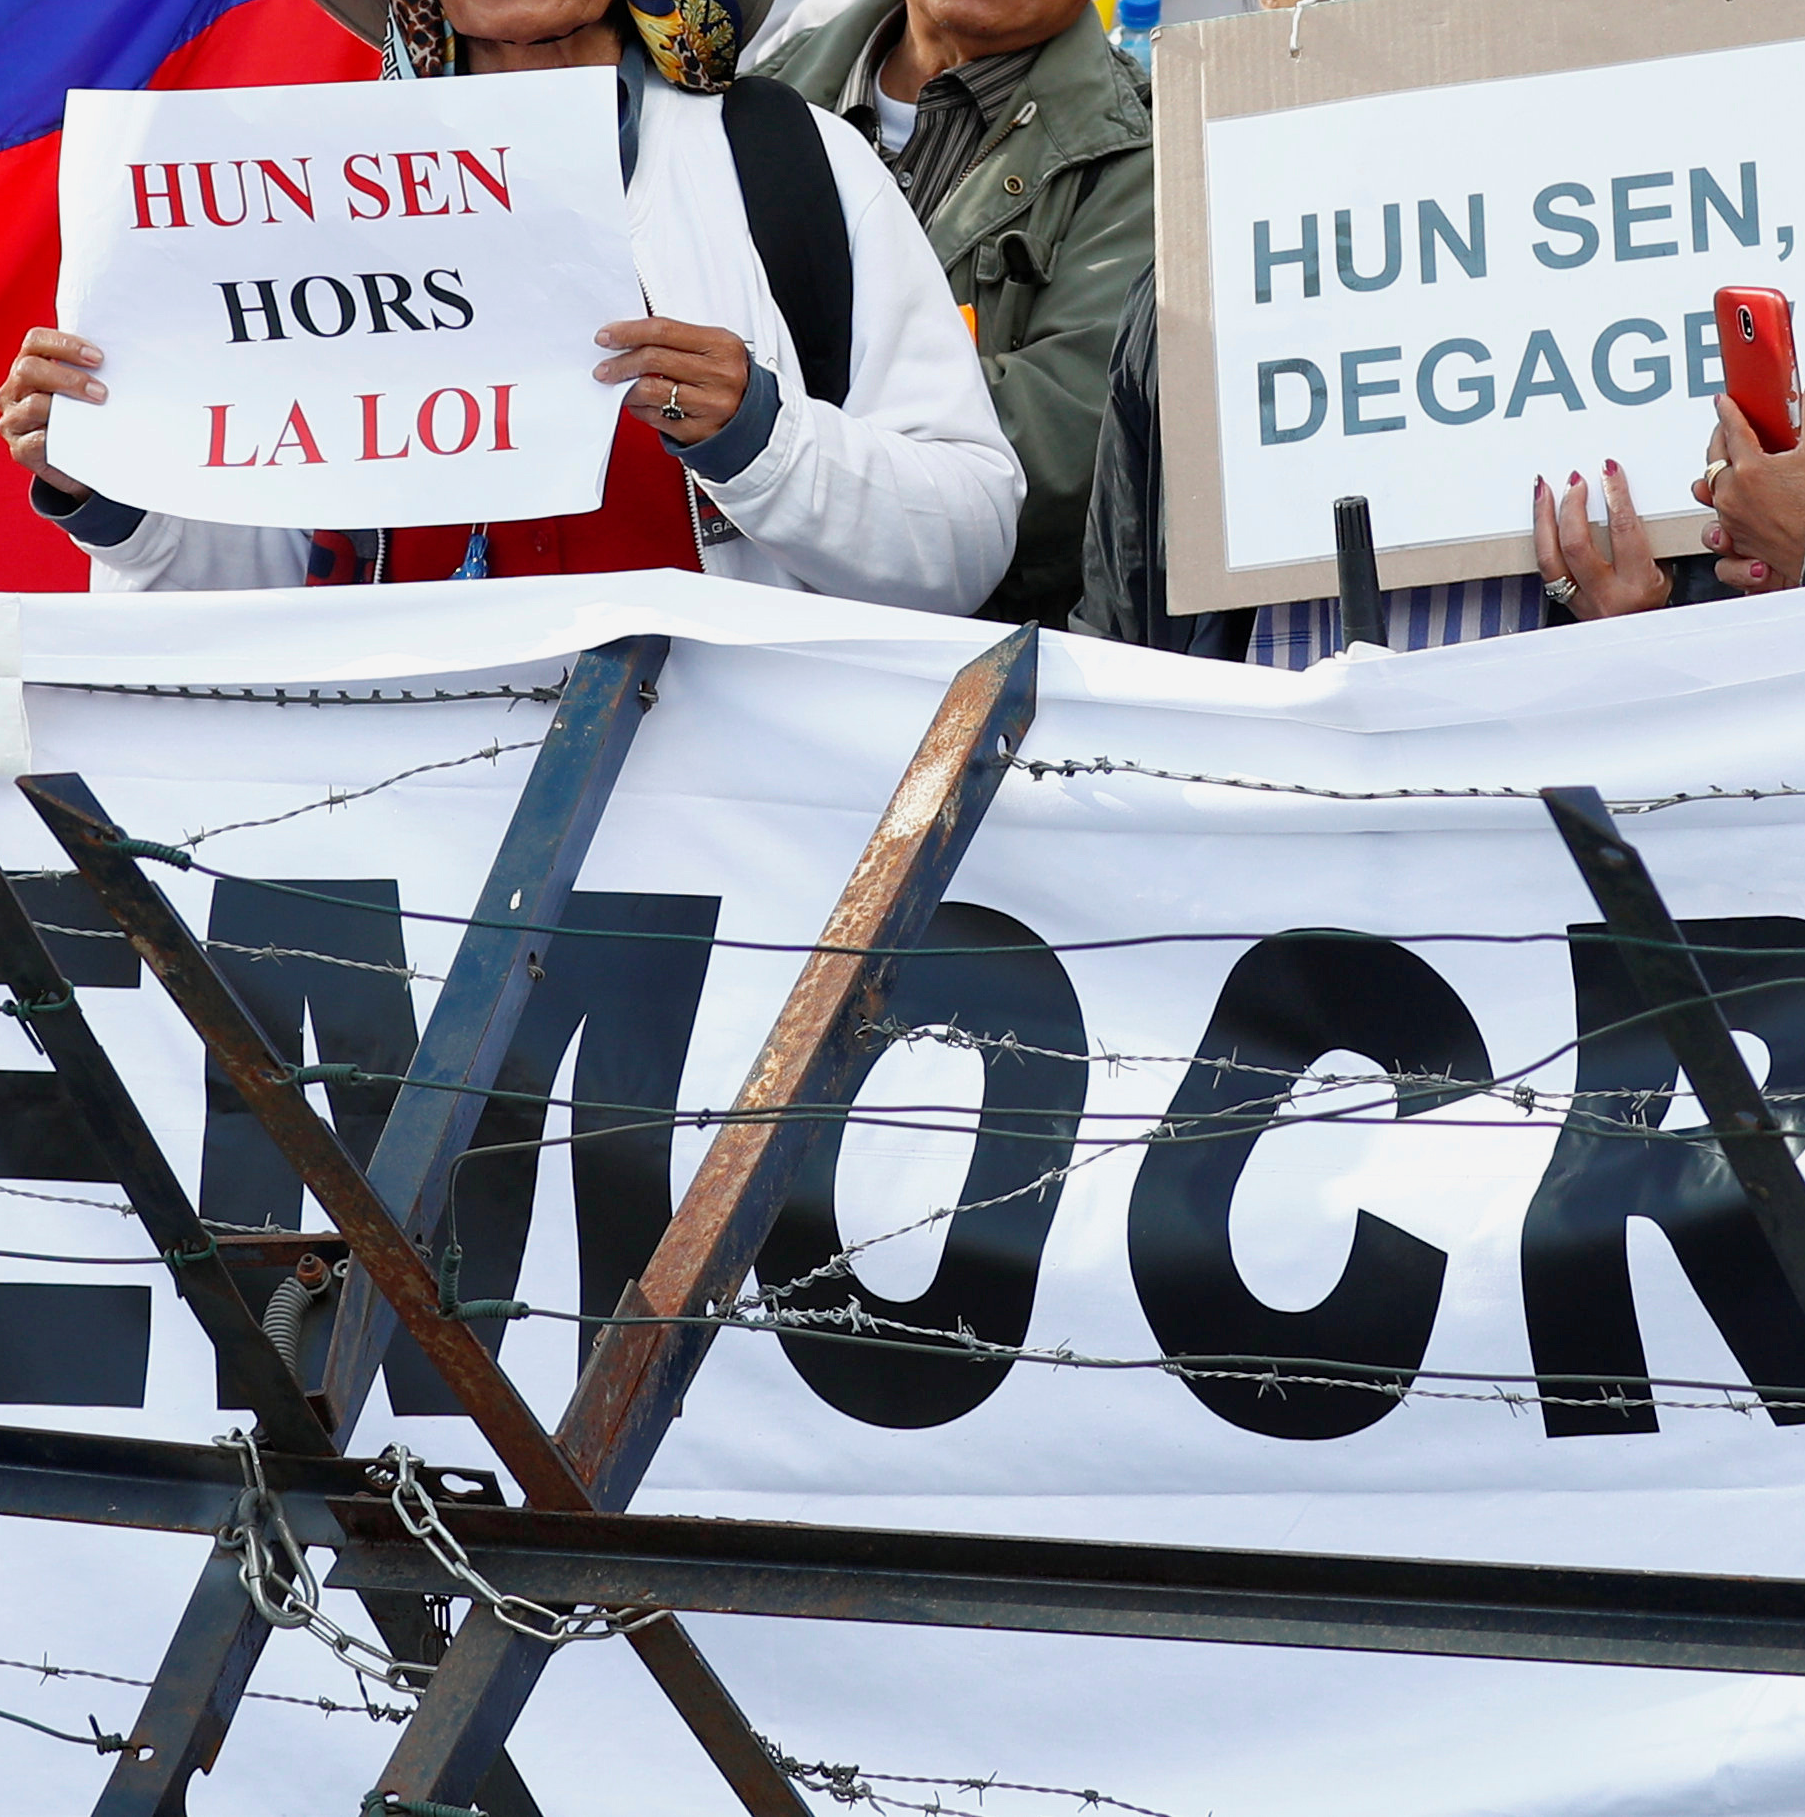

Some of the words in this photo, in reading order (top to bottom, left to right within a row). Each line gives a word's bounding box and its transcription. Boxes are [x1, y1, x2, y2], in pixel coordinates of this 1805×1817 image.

[128, 156, 316, 230] HUN
[342, 146, 513, 221] SEN
[1252, 193, 1488, 305] HUN
[1531, 160, 1795, 271] SEN,
[212, 269, 476, 344] HORS
[198, 399, 327, 469] LA
[355, 384, 519, 461] LOI
